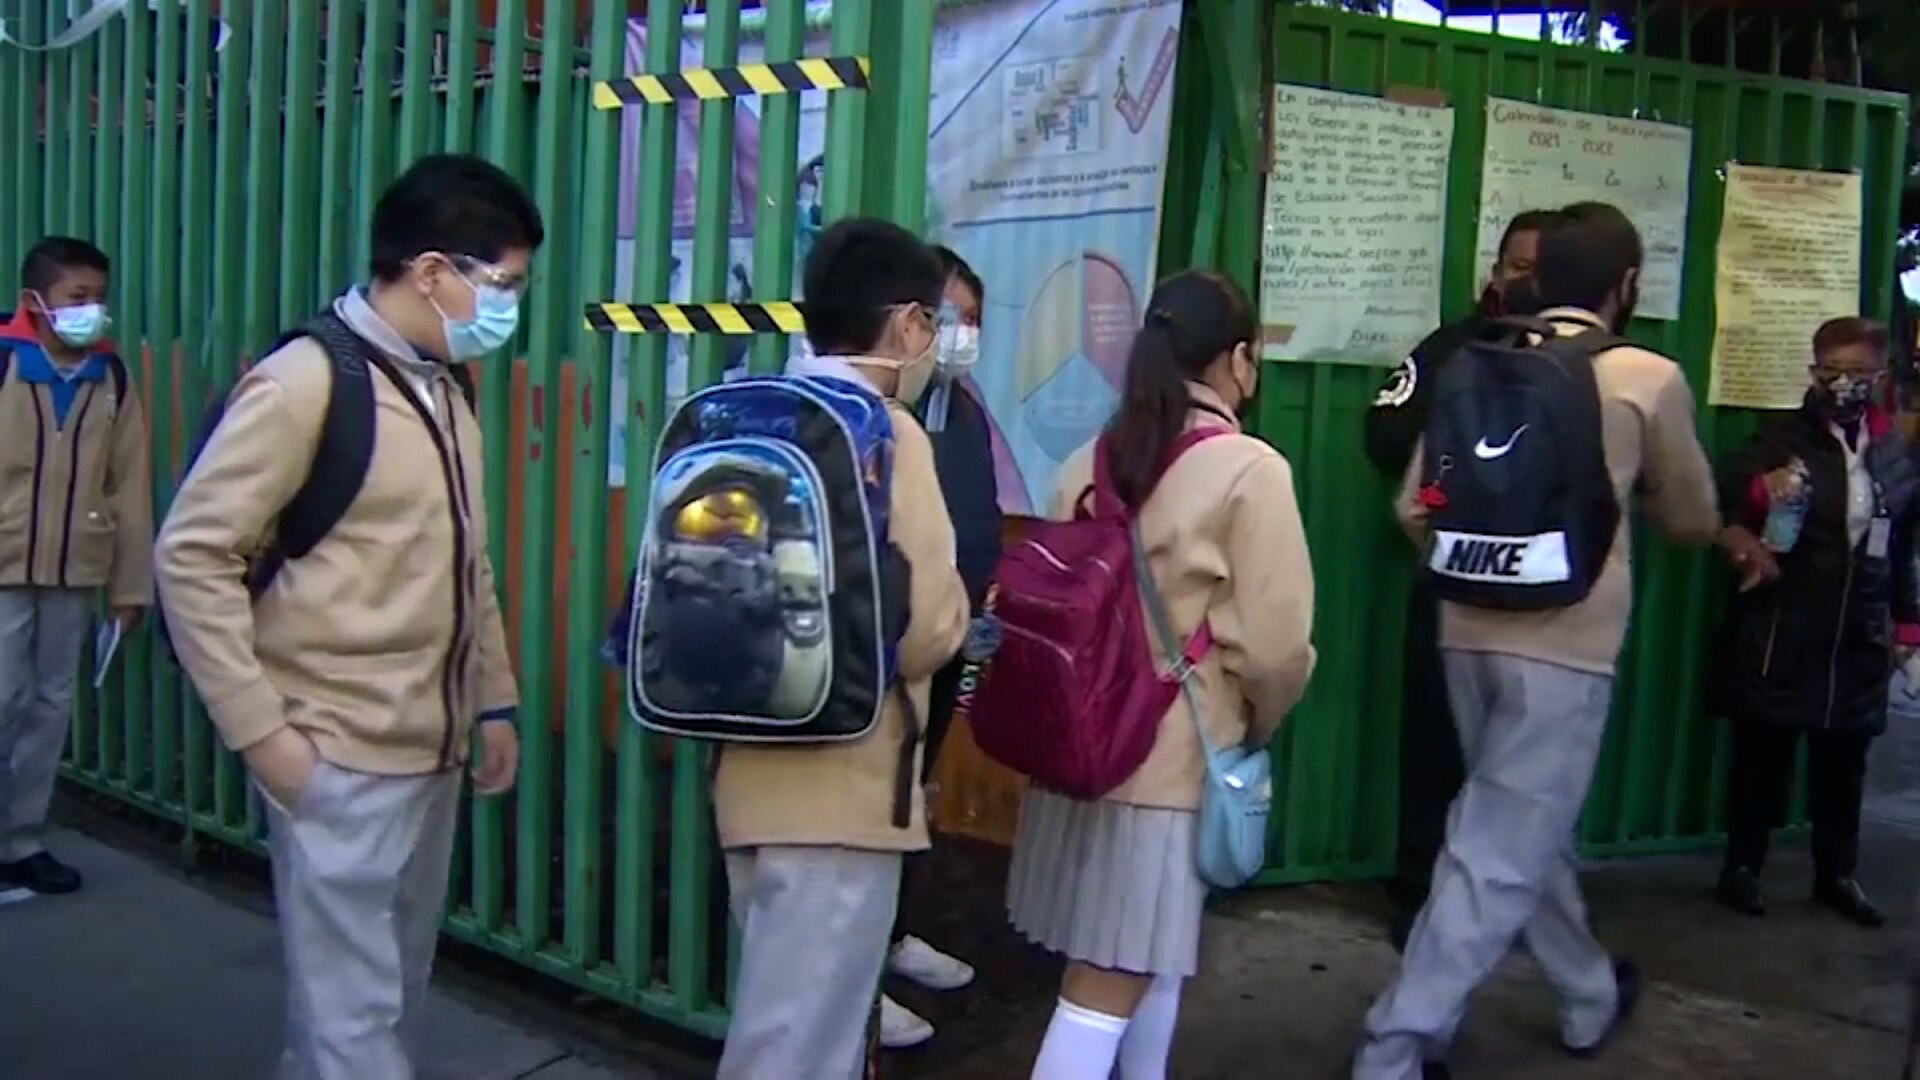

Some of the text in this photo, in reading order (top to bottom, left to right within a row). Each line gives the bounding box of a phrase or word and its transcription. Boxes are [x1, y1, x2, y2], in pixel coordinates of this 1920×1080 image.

[1528, 131, 1560, 148] 2021
[1582, 139, 1615, 155] 2022
[1446, 539, 1528, 576] NIKE
